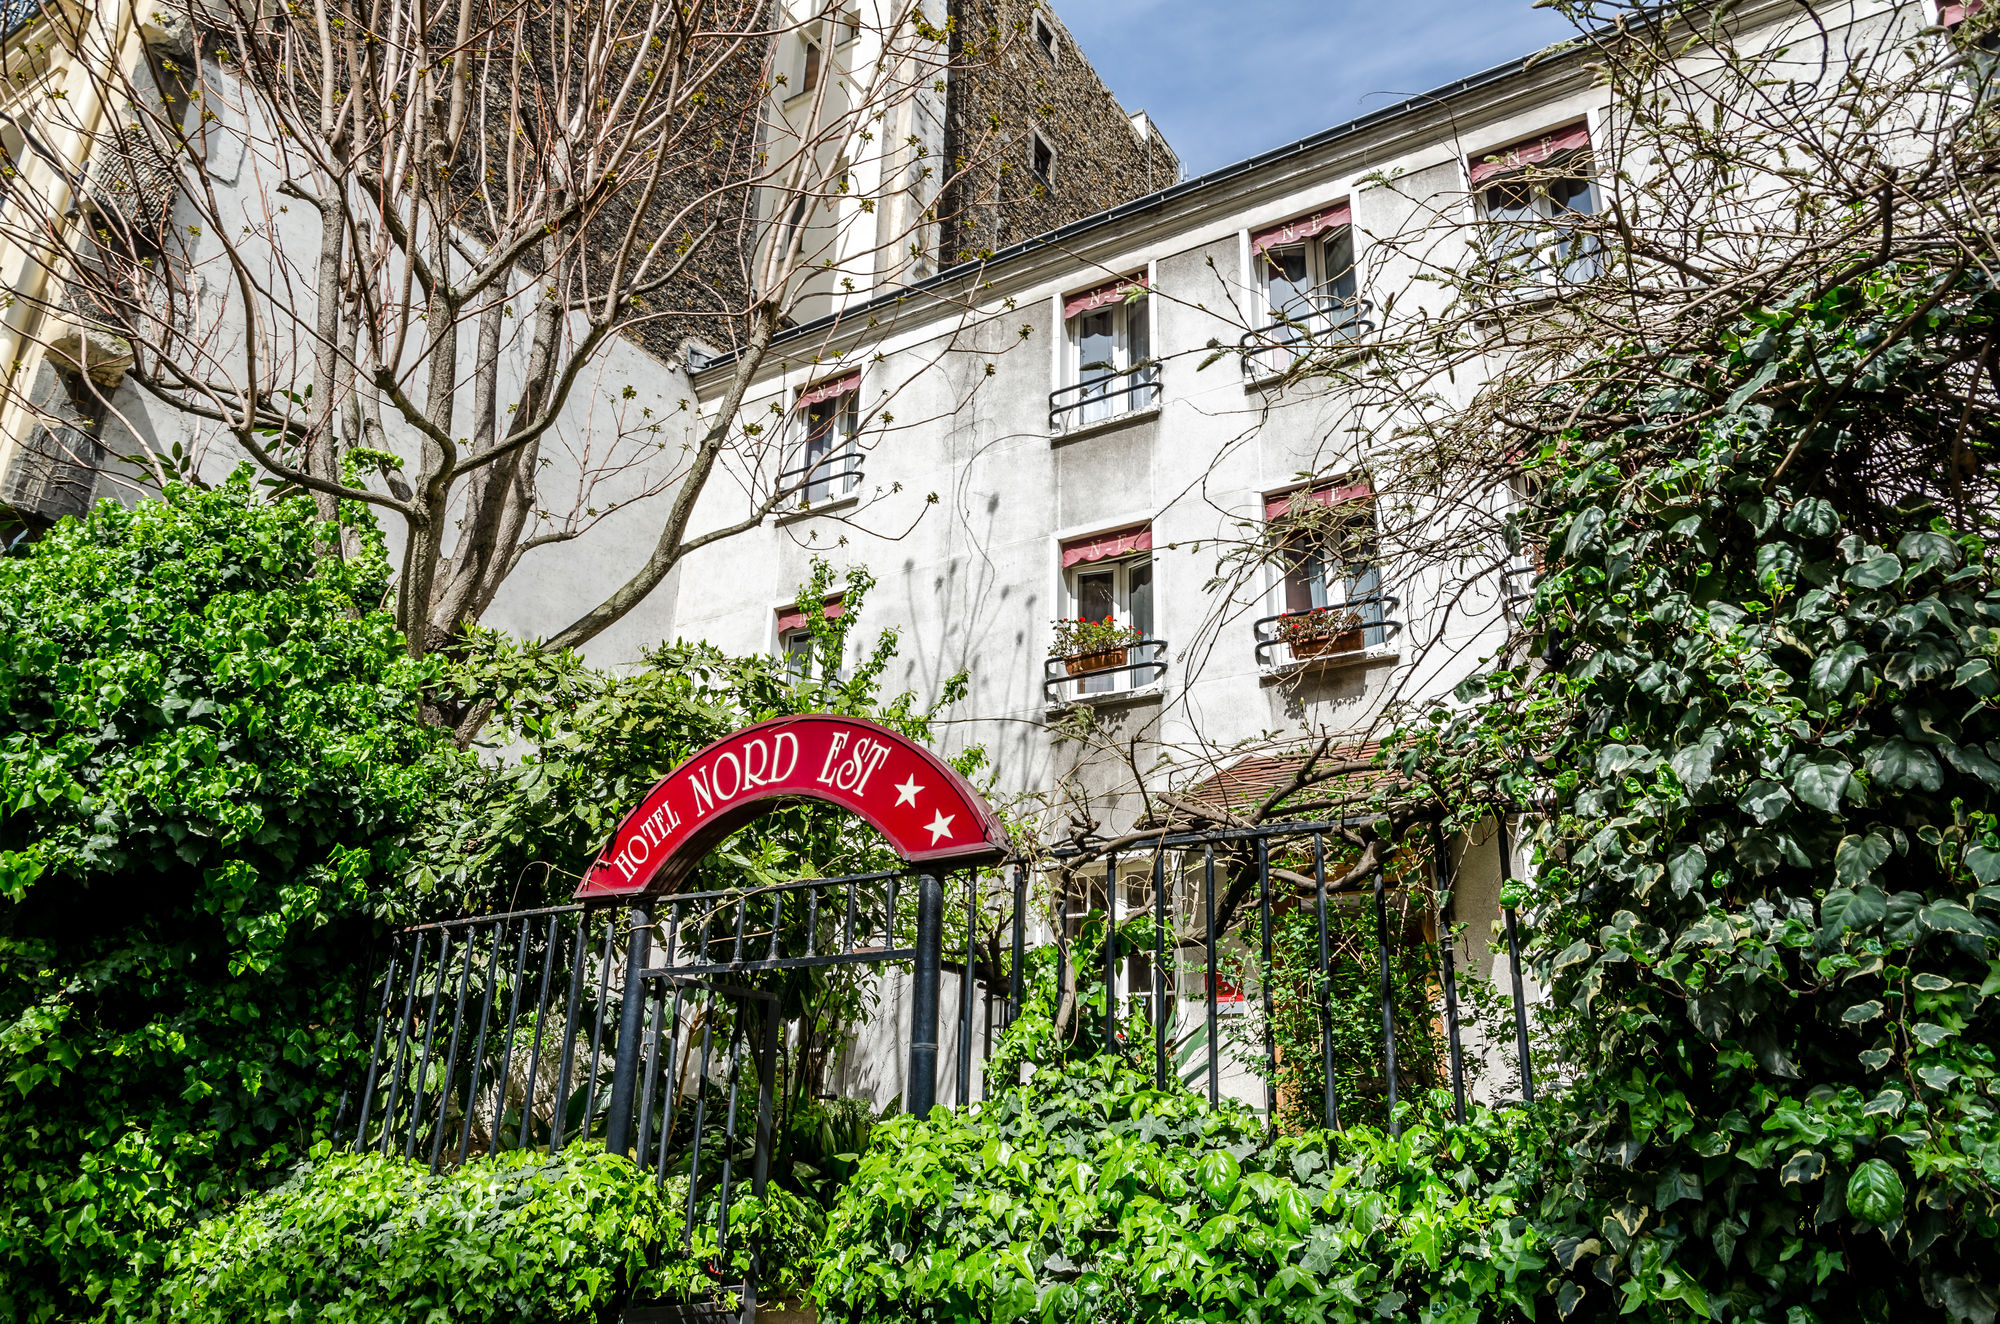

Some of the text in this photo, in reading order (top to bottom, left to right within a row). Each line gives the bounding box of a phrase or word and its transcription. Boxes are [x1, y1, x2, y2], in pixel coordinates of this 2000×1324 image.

[614, 731, 891, 882] HOTEL NORD EST
